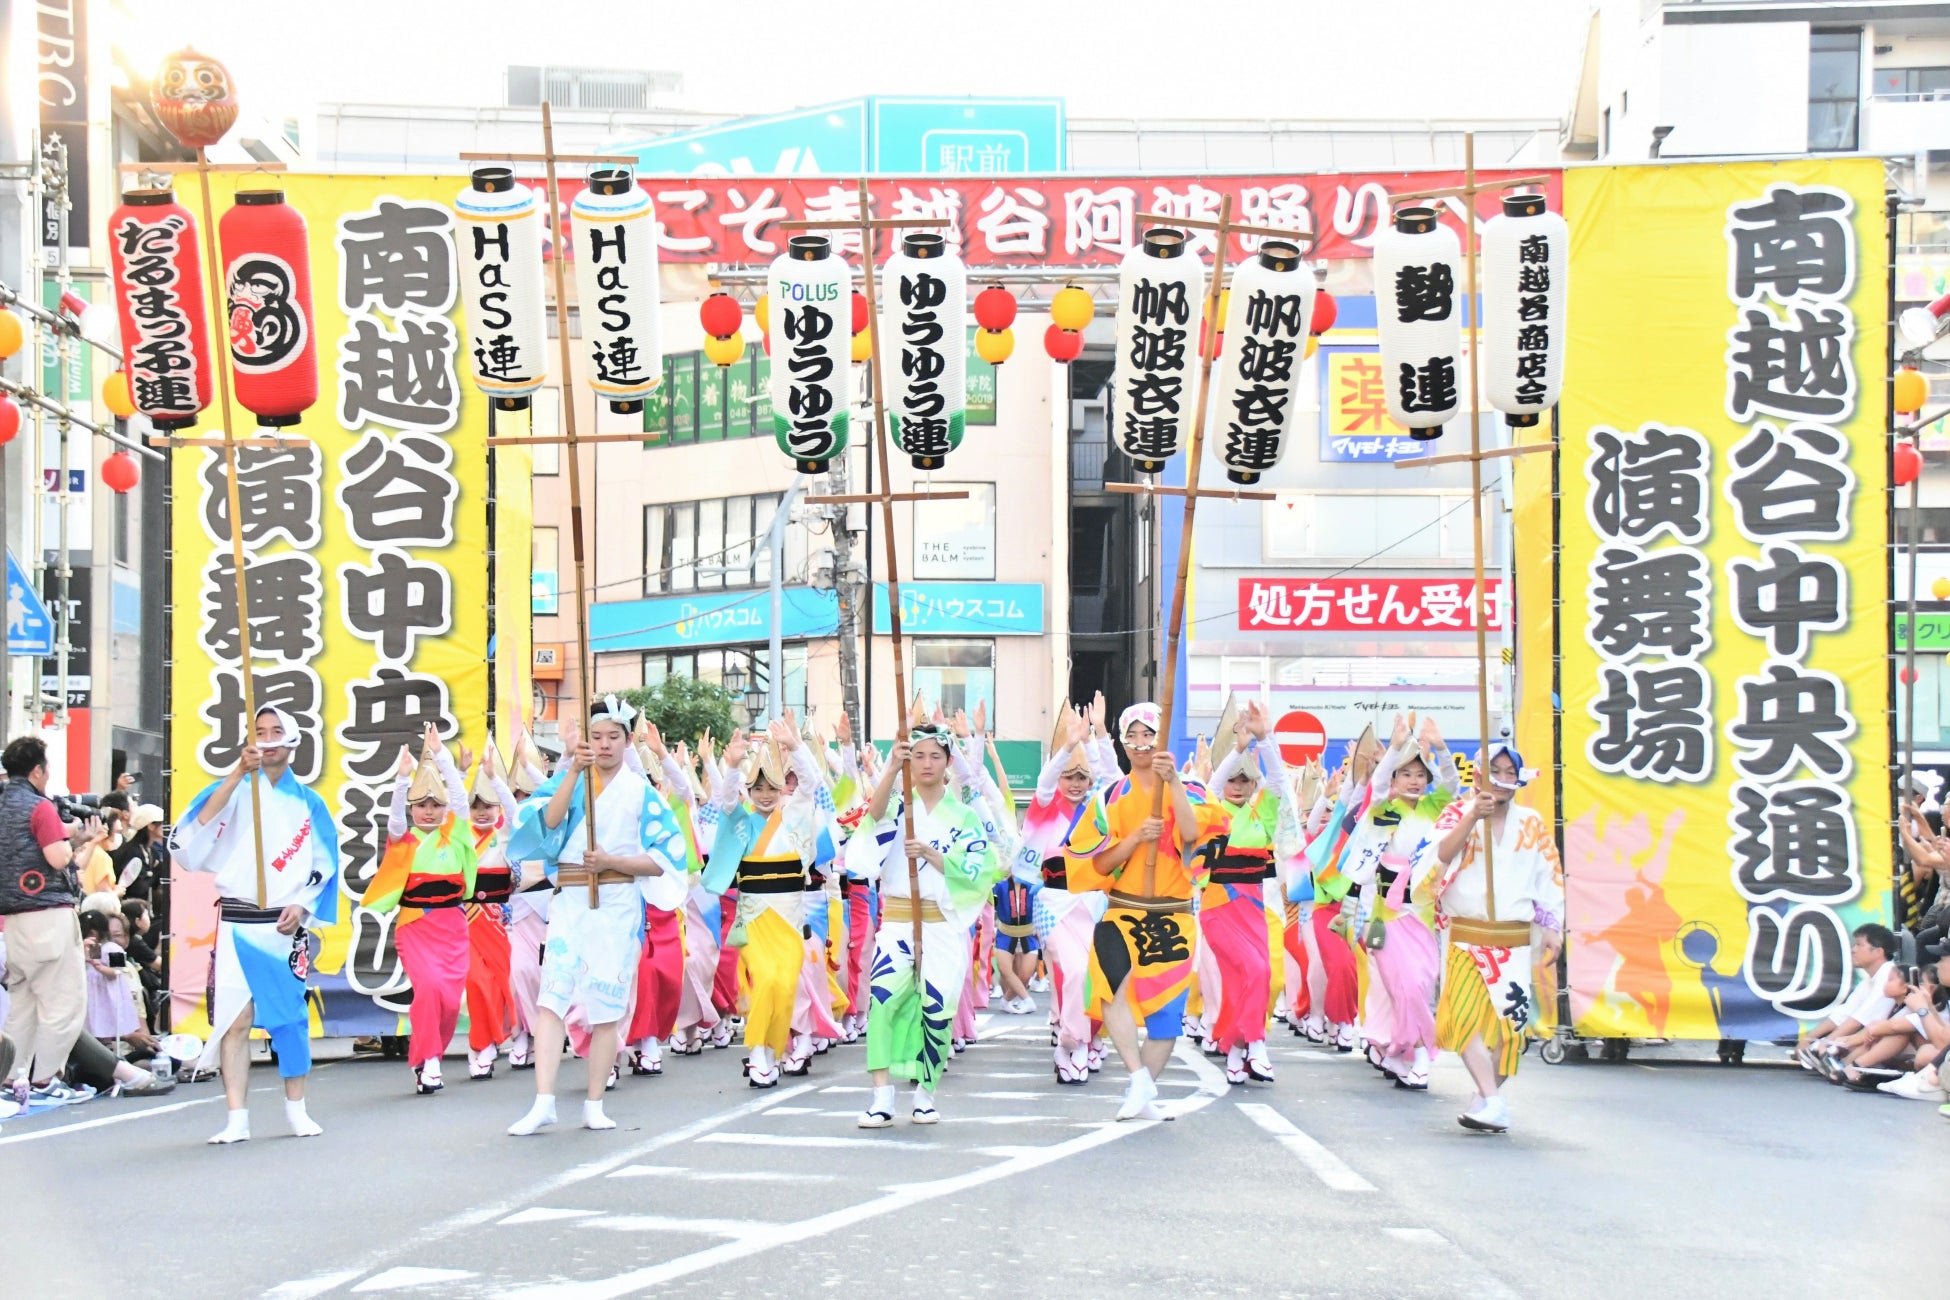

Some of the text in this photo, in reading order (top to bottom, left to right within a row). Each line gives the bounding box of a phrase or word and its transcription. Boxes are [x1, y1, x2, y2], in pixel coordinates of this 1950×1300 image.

[117, 217, 197, 412] だるまっ子連
[472, 223, 532, 383] HaS連
[590, 224, 650, 385] HaS連
[780, 280, 838, 301] POLUS
[899, 272, 952, 457] ゆうゆう連
[1516, 234, 1550, 405] 南越谷商店会
[784, 305, 834, 457] ゆうゆう
[341, 201, 451, 1008] 南越谷中央り
[698, 607, 762, 628] ハウスコム
[922, 542, 958, 562] THE BALM
[926, 600, 1024, 618] ハウスコム
[1249, 583, 1503, 626] 処方せん受付
[1592, 427, 1704, 775] 演舞場
[1731, 188, 1853, 1011] 南越谷中央通り
